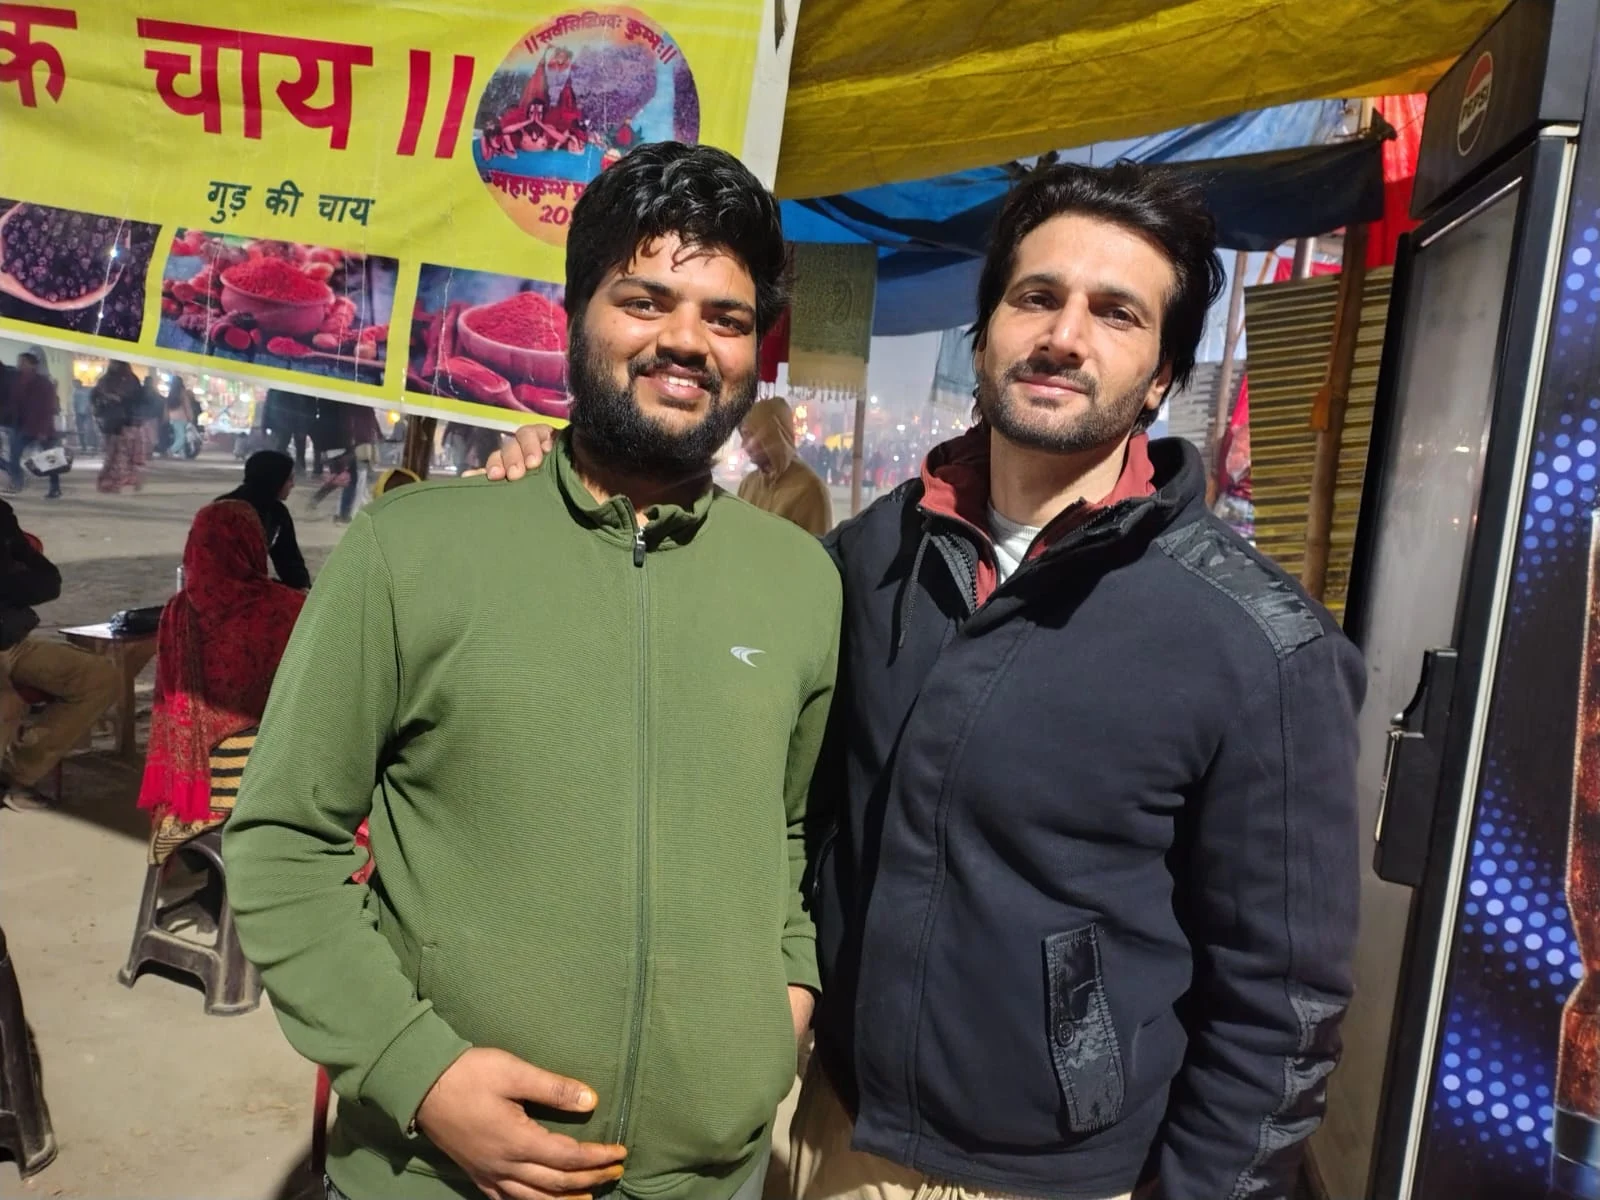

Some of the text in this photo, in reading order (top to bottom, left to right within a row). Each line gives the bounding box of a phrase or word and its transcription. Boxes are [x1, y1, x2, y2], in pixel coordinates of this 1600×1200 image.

[137, 18, 373, 150] चाय
[207, 180, 376, 226] गुड़ की चाय
[538, 204, 570, 226] 20
